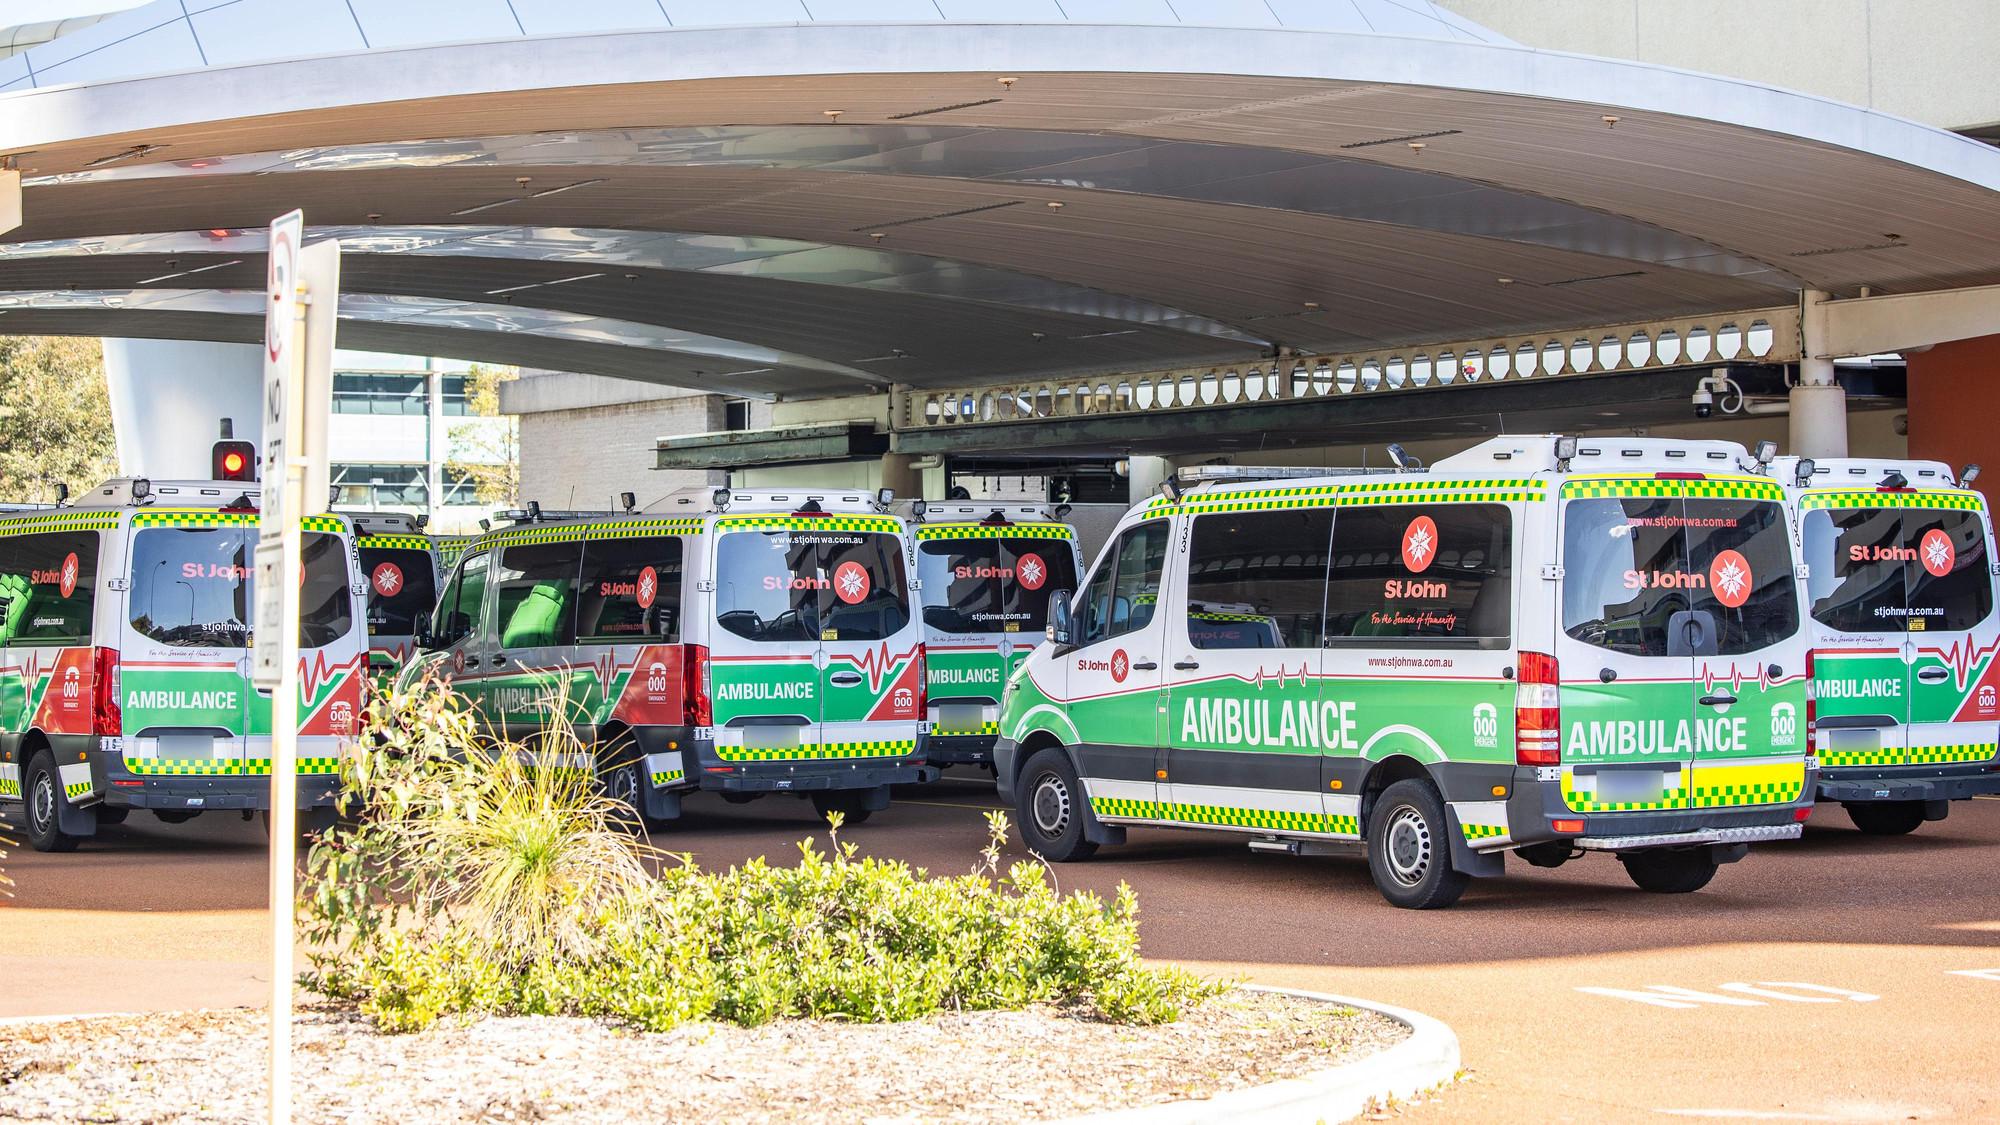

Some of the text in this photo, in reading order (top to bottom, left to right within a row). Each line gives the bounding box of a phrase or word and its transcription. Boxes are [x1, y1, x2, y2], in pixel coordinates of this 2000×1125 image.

[267, 378, 281, 425] NO
[1627, 516, 1737, 529] www.stjohnwa.com.au
[770, 535, 863, 546] www.stjohnwa.com.au
[1181, 515, 1190, 553] 133
[349, 535, 359, 570] 257
[1850, 545, 1917, 561] St John
[31, 569, 60, 585] St John
[182, 562, 205, 578] St
[955, 566, 1013, 579] St John
[763, 576, 830, 590] St John
[1623, 569, 1706, 589] St John
[601, 582, 635, 596] St John
[1384, 579, 1446, 599] St John
[972, 612, 1031, 622] stjohnwa.com.au
[1874, 606, 1944, 618] stjohnwa.com.au
[202, 622, 254, 634] stjohnwa.c
[1371, 611, 1457, 631] For the Service of Humanity
[1078, 659, 1109, 671] St John
[1368, 656, 1453, 669] www.stjohnwa.com.au
[648, 676, 666, 692] 000
[928, 668, 999, 684] MBULANCE
[64, 682, 78, 698] 000
[717, 682, 814, 700] AMBULANCE
[1816, 679, 1901, 698] MBULANCE
[127, 690, 237, 709] AMBULANCE
[894, 696, 912, 707] 000
[1979, 695, 1996, 707] 000
[1181, 697, 1358, 749] AMBULANCE
[1473, 717, 1497, 736] 000
[1771, 716, 1795, 735] 000
[1567, 717, 1747, 756] AMBULANCE
